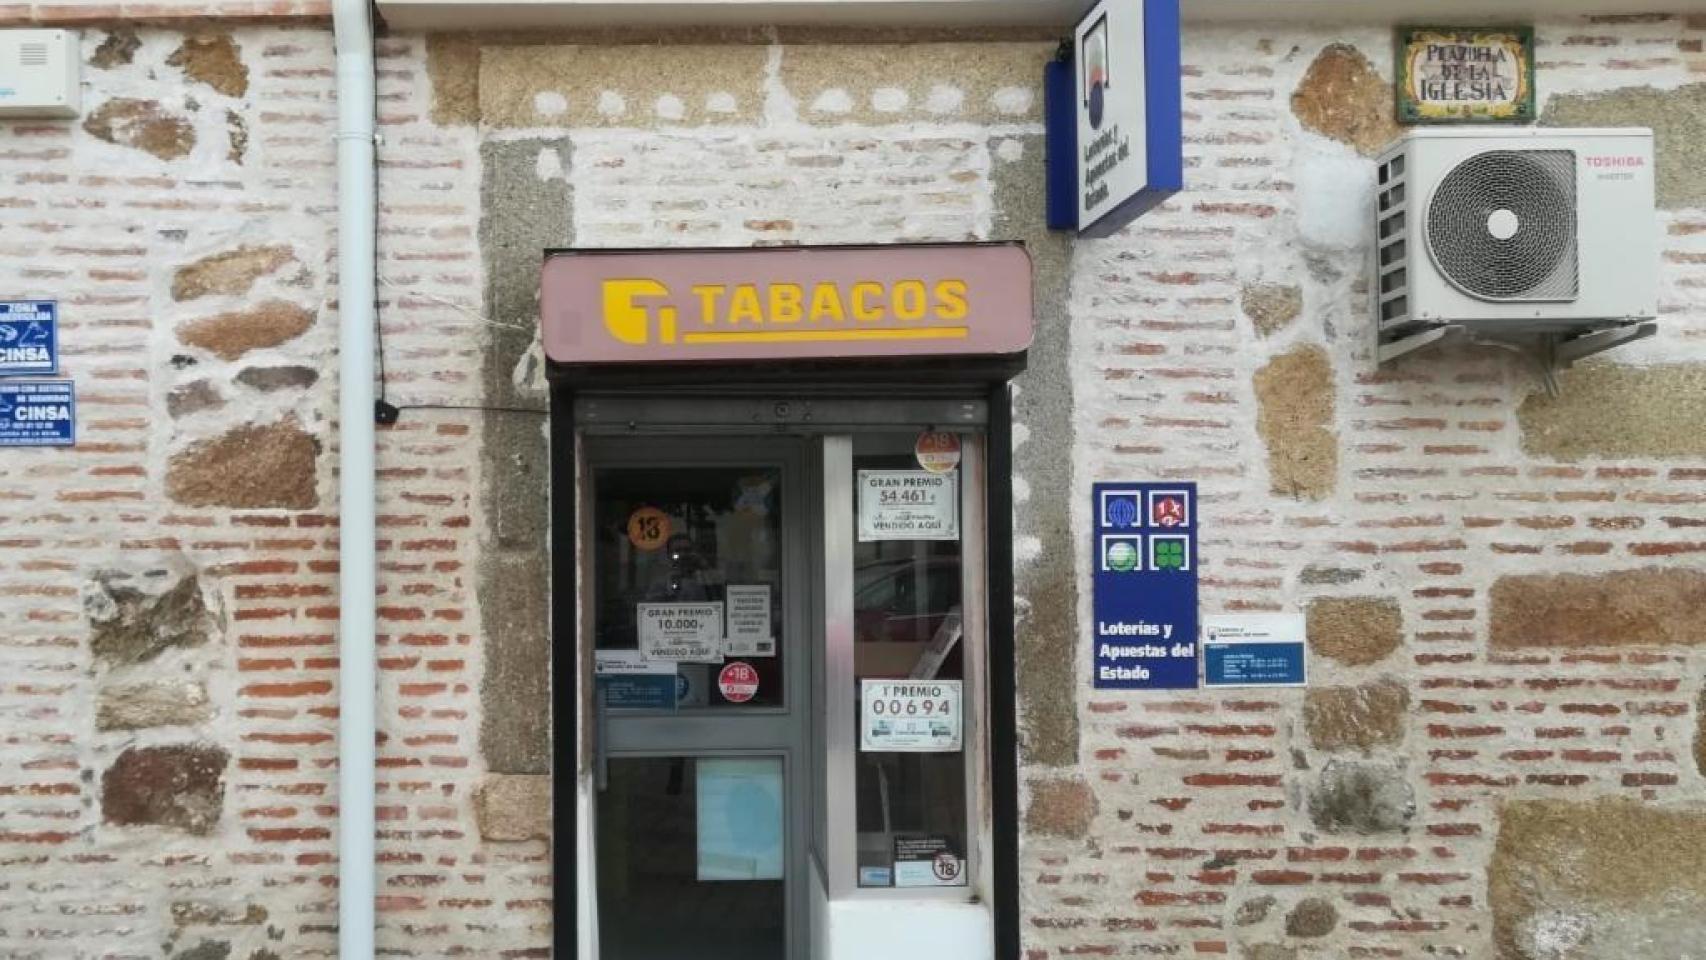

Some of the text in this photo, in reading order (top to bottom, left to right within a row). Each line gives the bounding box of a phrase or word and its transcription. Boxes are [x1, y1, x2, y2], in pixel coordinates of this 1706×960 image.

[1470, 64, 1490, 80] LA
[1420, 79, 1507, 101] IGLESIA
[1584, 155, 1645, 167] TOSHIBA
[692, 279, 970, 324] TABACOS
[14, 405, 69, 420] CINSA
[869, 478, 943, 488] GRAN PREMIO
[873, 520, 915, 530] VENDIDO
[648, 608, 713, 617] GRAN PREMIO
[658, 619, 698, 629] 10.000
[1100, 620, 1173, 639] Loterías y
[1100, 643, 1195, 661] Apuestas del
[1100, 666, 1150, 680] Estado
[893, 686, 942, 698] PREMIO
[873, 699, 951, 716] 00694
[938, 862, 955, 876] 18
